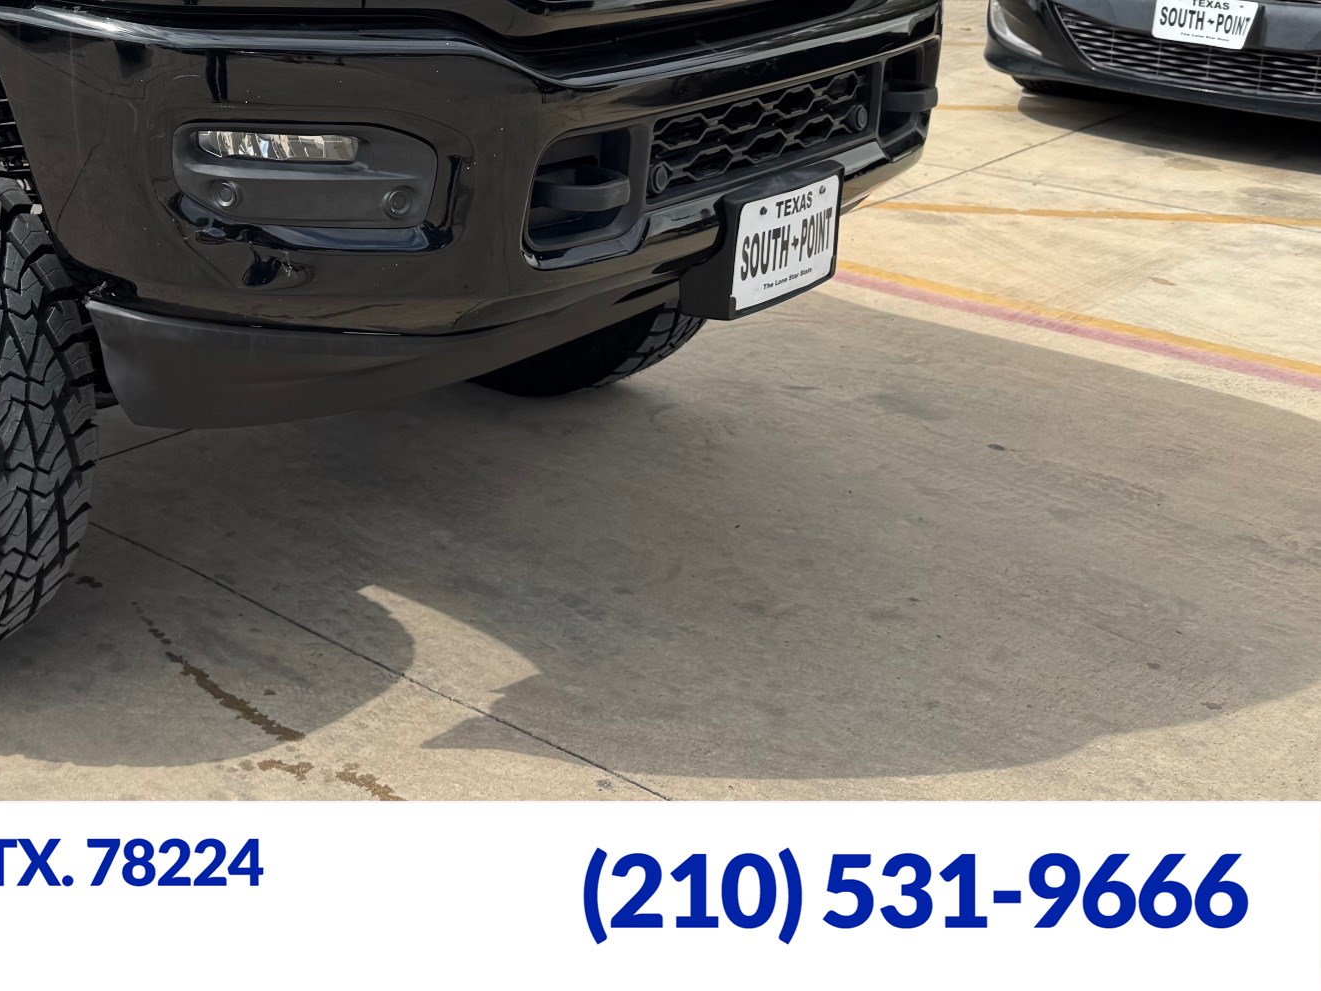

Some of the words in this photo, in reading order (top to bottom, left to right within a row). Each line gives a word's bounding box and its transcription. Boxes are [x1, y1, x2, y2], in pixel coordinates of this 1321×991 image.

[776, 191, 813, 219] TEXAS
[763, 282, 774, 290] The
[775, 277, 788, 286] Lone
